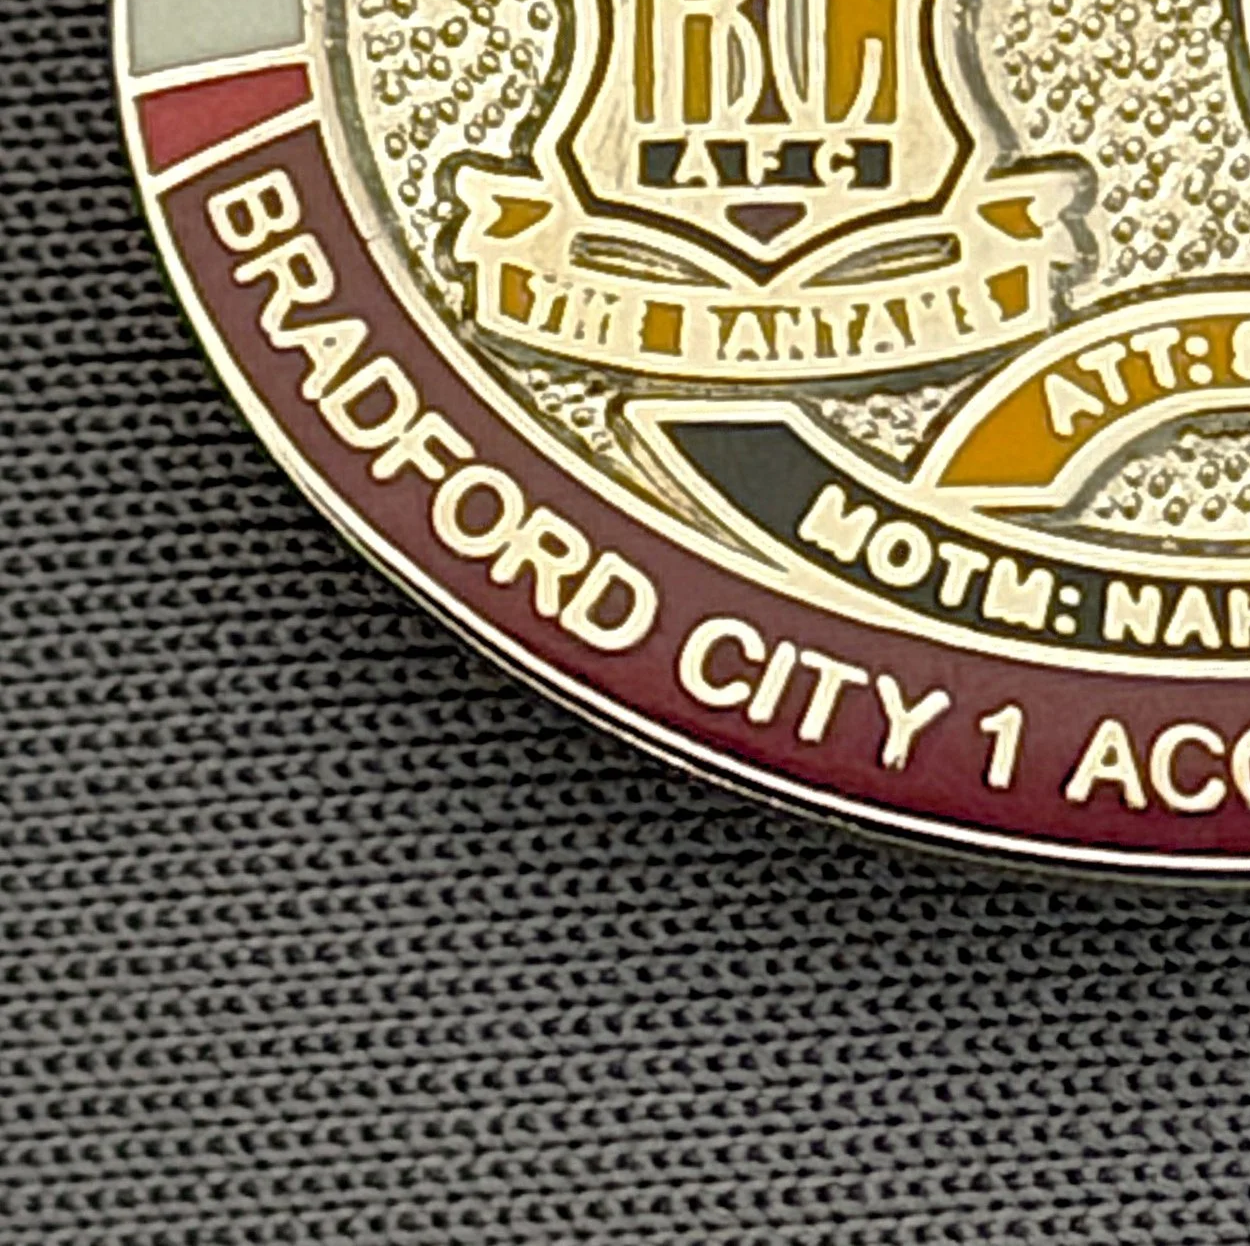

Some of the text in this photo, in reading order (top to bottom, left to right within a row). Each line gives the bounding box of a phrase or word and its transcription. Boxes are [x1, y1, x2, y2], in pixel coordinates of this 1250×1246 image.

[1042, 327, 1209, 436] ATT:
[206, 170, 657, 651] BRADFORD
[678, 616, 950, 768] CITY
[981, 705, 1022, 788] 1
[797, 483, 1081, 634] MOTM:
